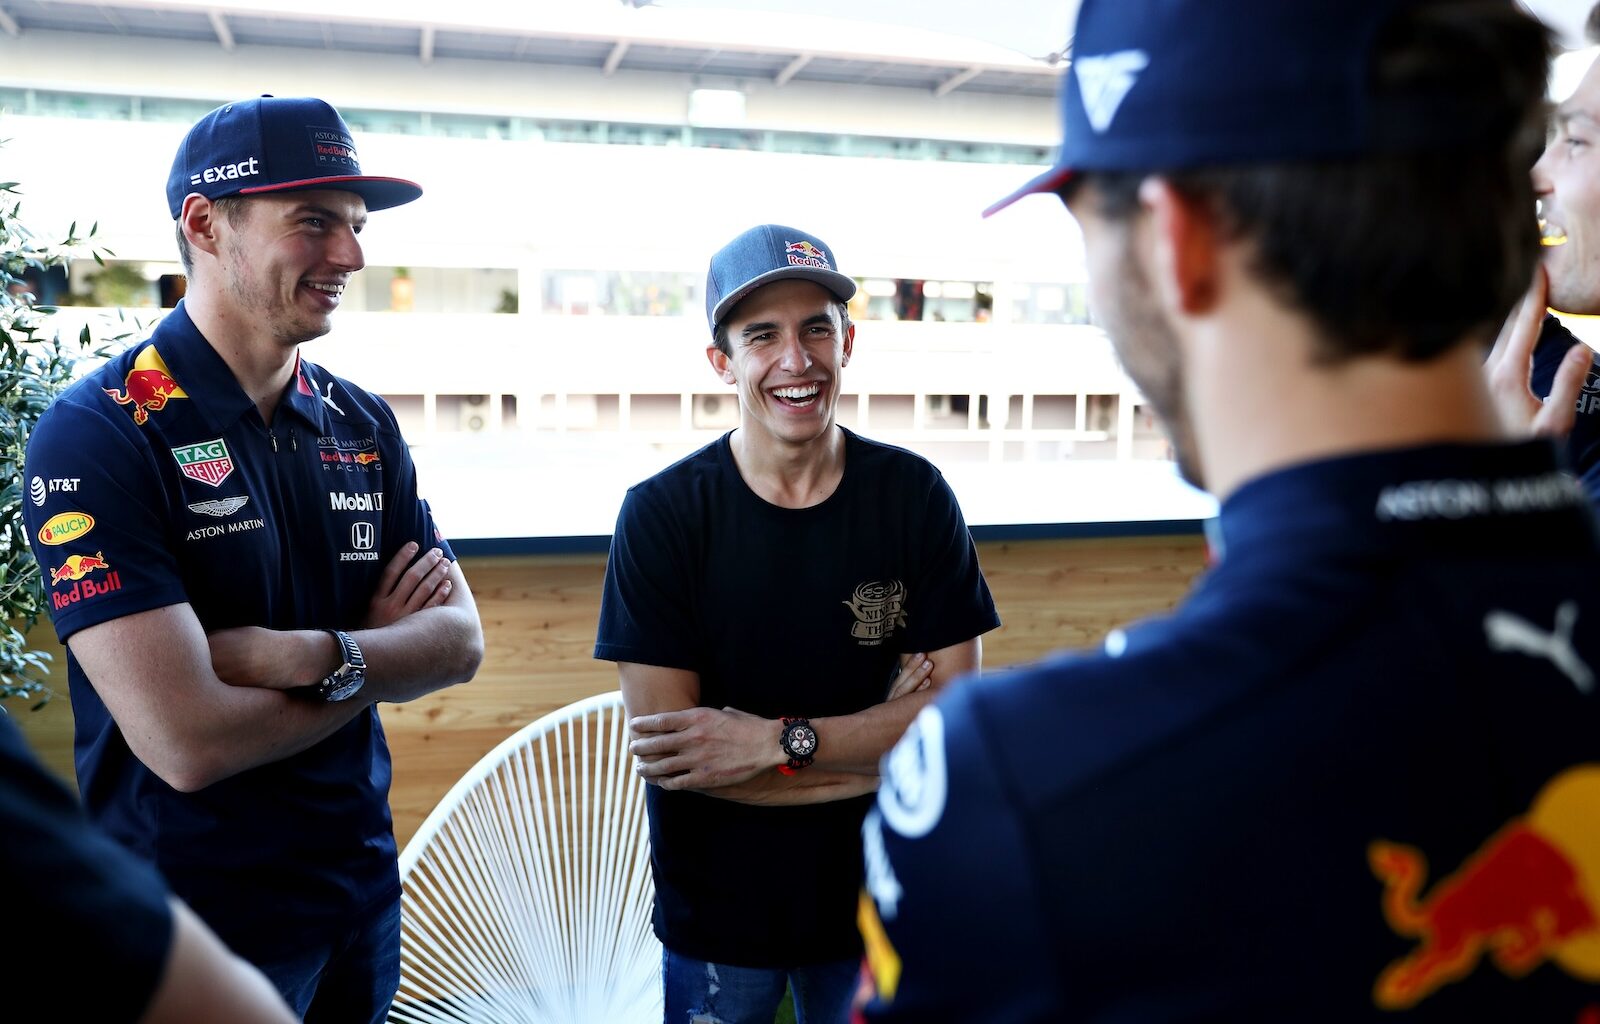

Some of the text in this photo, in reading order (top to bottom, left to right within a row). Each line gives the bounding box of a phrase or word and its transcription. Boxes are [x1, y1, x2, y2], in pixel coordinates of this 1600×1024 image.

[314, 132, 339, 141] ASTON
[316, 144, 334, 155] Red
[787, 254, 811, 266] Red
[176, 443, 223, 463] TAG
[320, 451, 339, 462] Red
[184, 460, 230, 484] HEUER
[322, 463, 383, 473] RACING
[48, 478, 81, 493] AT&T
[330, 492, 373, 511] Mobil
[51, 517, 88, 537] RAUCH
[186, 518, 265, 541] ASTON MARTIN
[339, 551, 379, 562] HONDA
[52, 571, 122, 610] Red Bull
